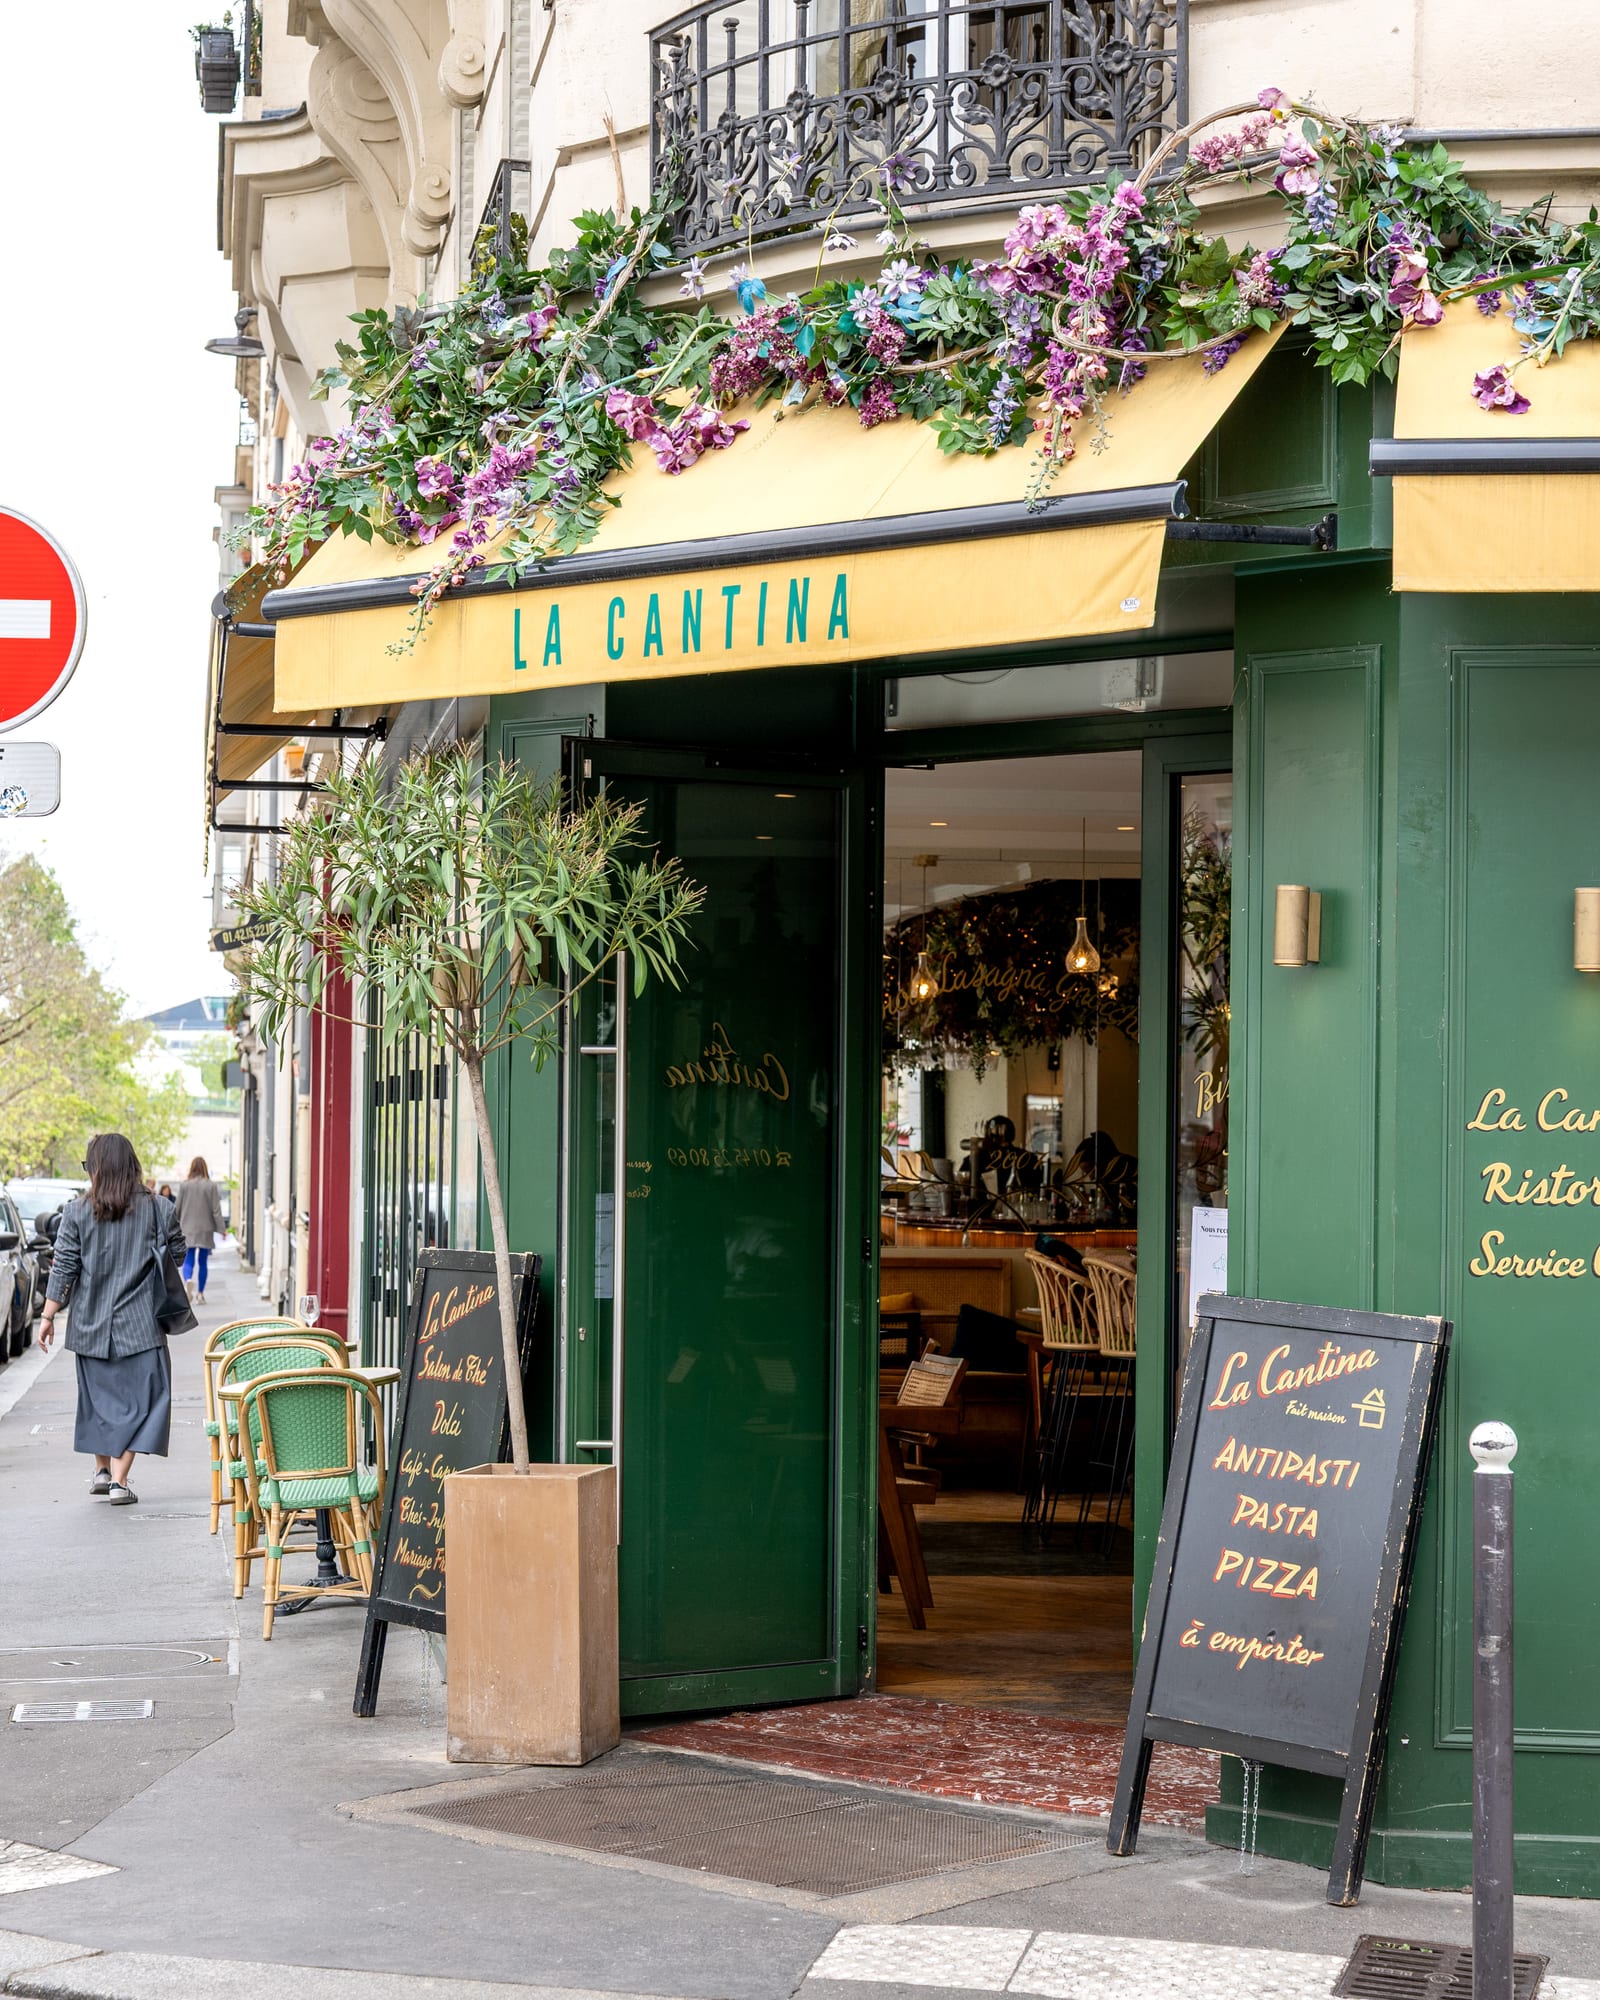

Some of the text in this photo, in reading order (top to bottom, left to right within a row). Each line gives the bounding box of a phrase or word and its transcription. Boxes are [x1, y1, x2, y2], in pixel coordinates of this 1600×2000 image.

[514, 573, 848, 670] LA CANTINA
[1193, 1066, 1229, 1119] Bi
[1466, 1088, 1527, 1132] La
[1469, 1230, 1587, 1278] Service
[418, 1284, 496, 1344] La Cantina
[417, 1345, 452, 1380] Salon
[452, 1359, 463, 1382] de
[1208, 1341, 1380, 1411] La Cantina
[1285, 1400, 1347, 1424] Fait maison
[1212, 1435, 1361, 1490] ANTIPASTI
[1231, 1493, 1319, 1539] PASTA
[394, 1537, 432, 1578] Mariage
[1213, 1547, 1318, 1600] PIZZA
[1207, 1629, 1325, 1672] emporter
